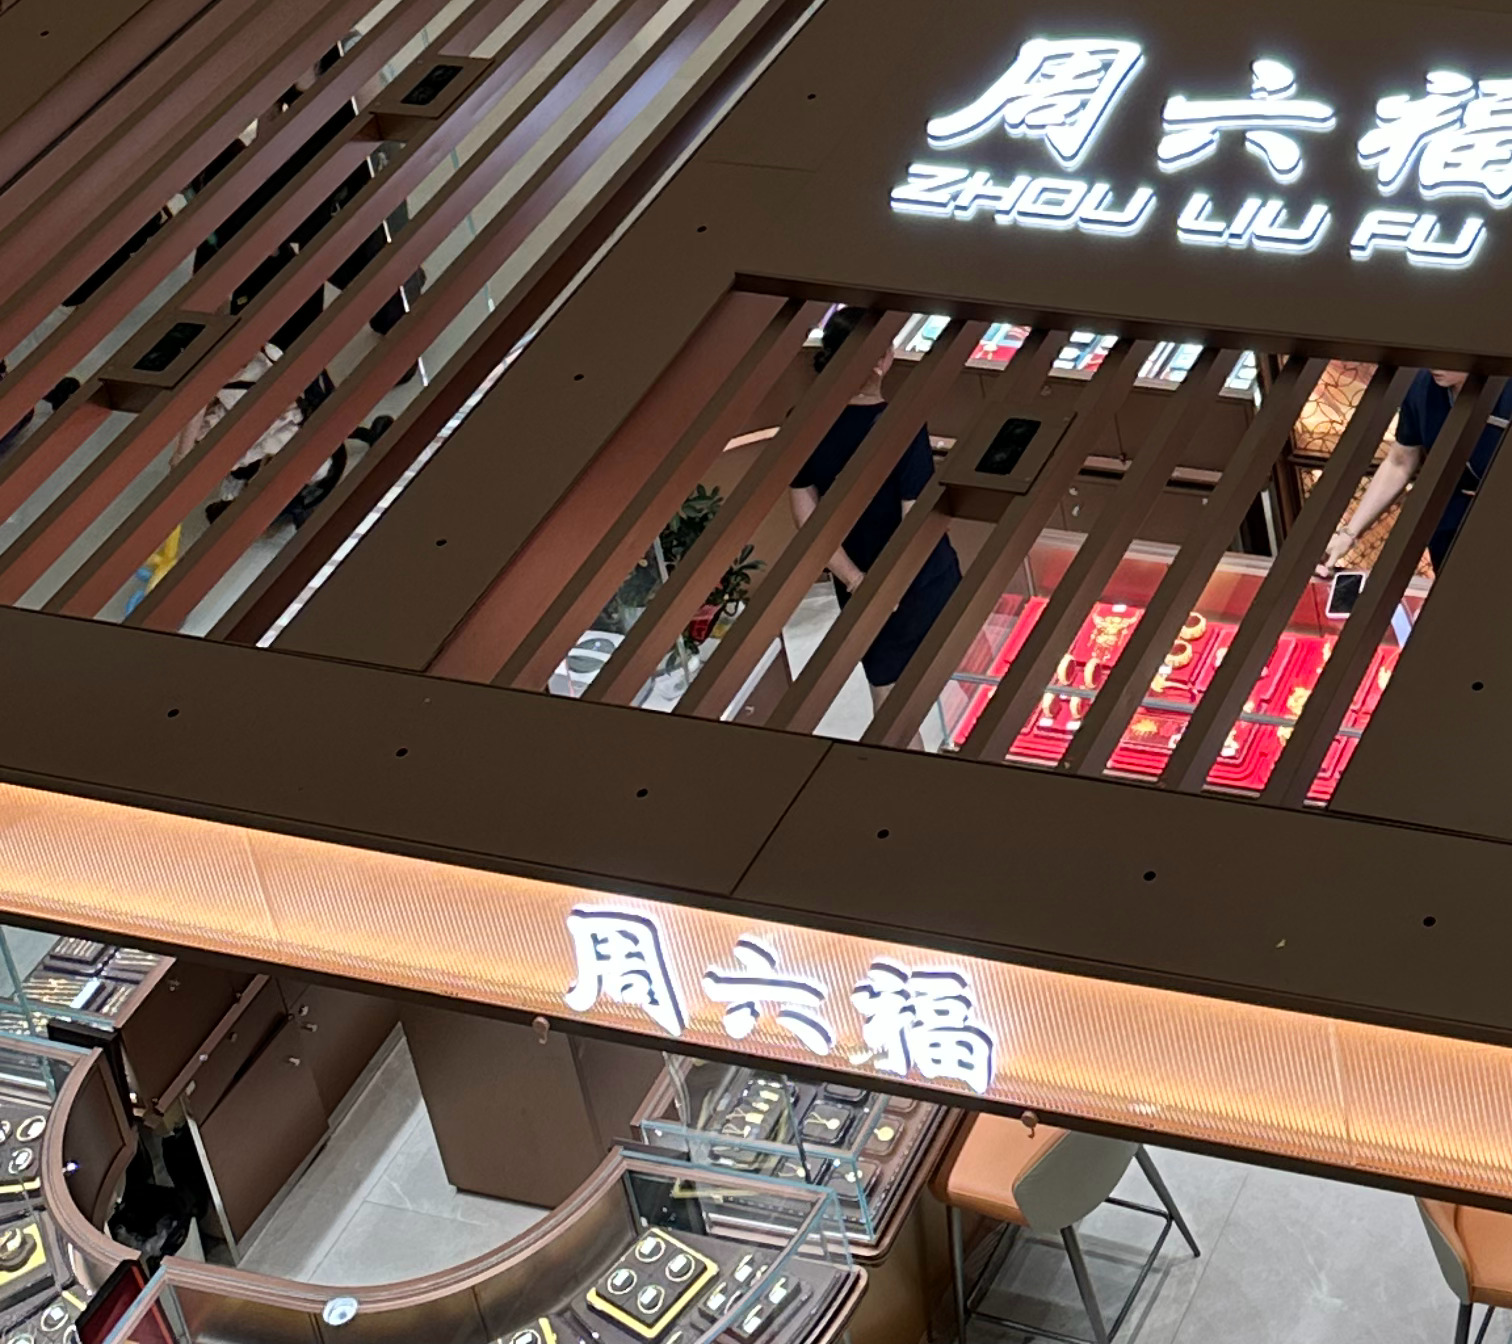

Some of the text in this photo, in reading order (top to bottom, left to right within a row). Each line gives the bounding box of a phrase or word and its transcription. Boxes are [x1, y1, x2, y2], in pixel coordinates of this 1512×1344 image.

[890, 163, 1486, 269] ZHOU LIU FU
[564, 904, 999, 1095] 周六福
